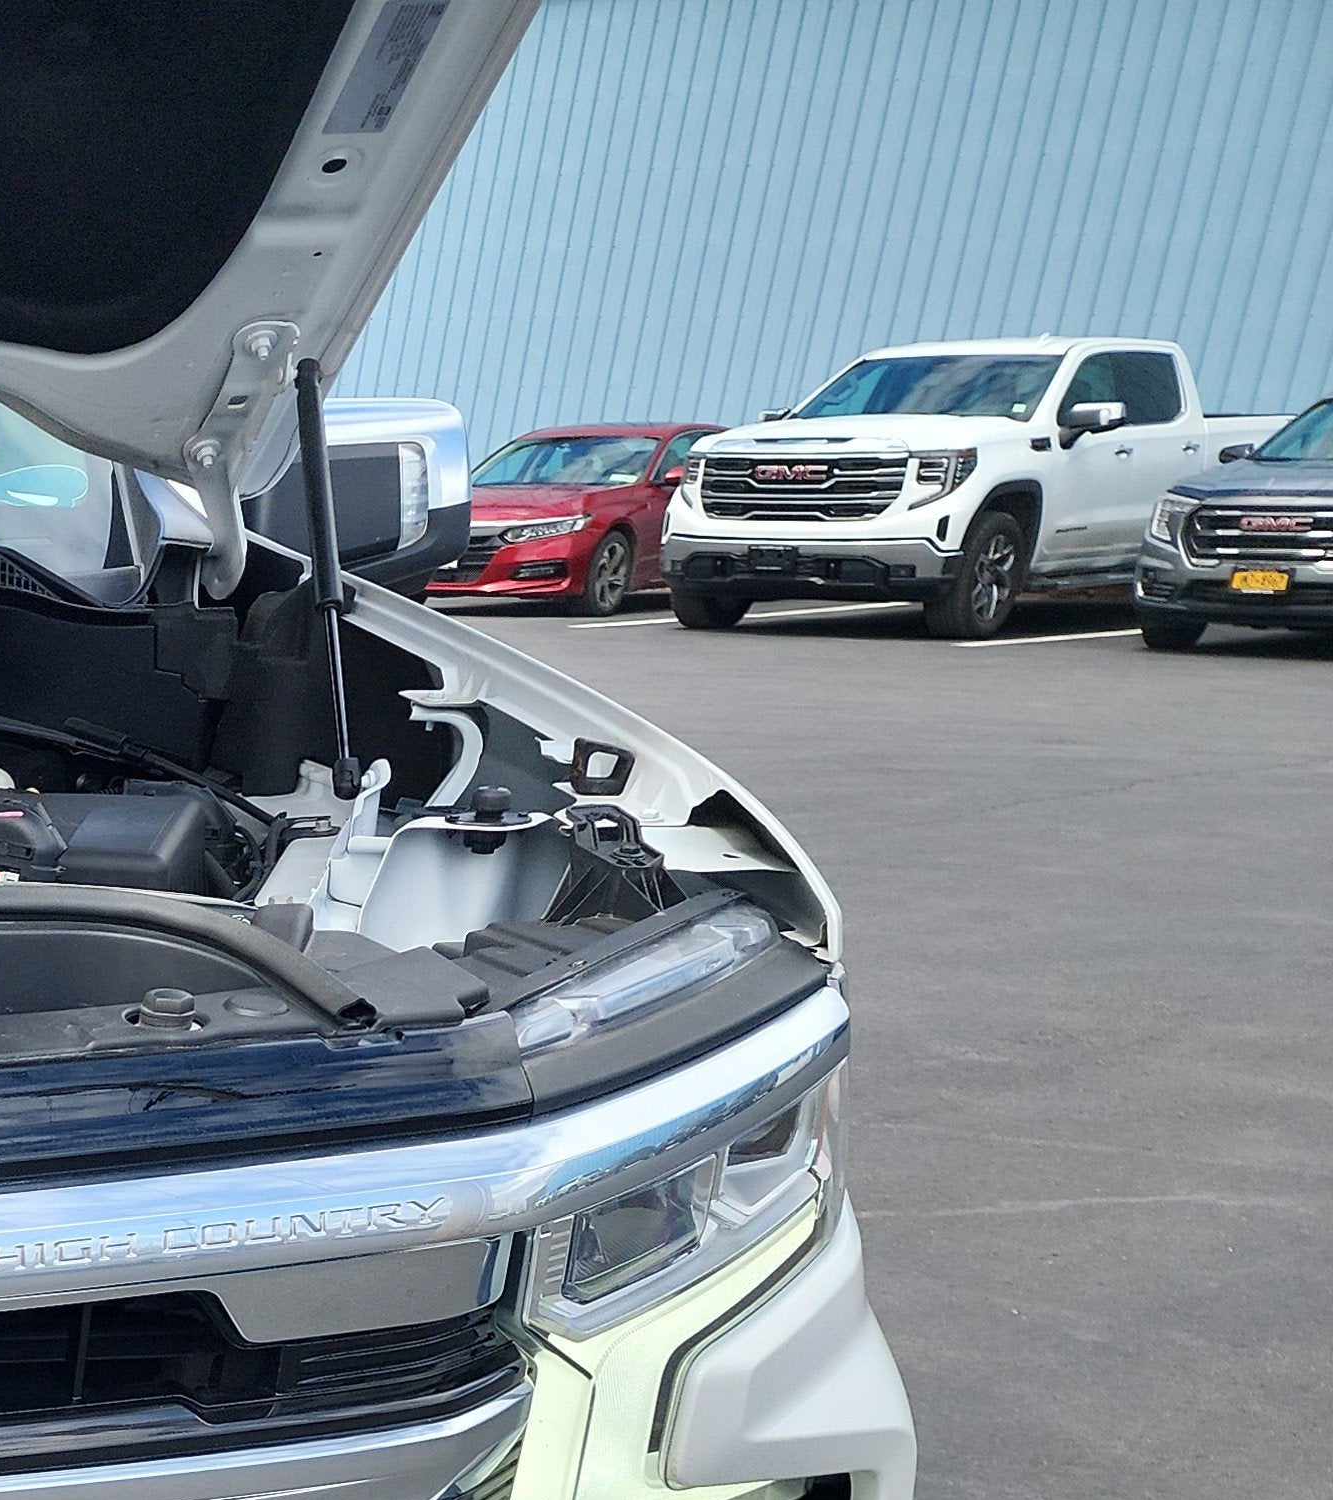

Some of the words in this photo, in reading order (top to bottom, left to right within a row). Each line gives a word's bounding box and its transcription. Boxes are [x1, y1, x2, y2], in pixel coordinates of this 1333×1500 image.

[754, 464, 829, 481] GMC
[1239, 516, 1314, 532] GMC
[162, 1194, 449, 1255] COUNTRY
